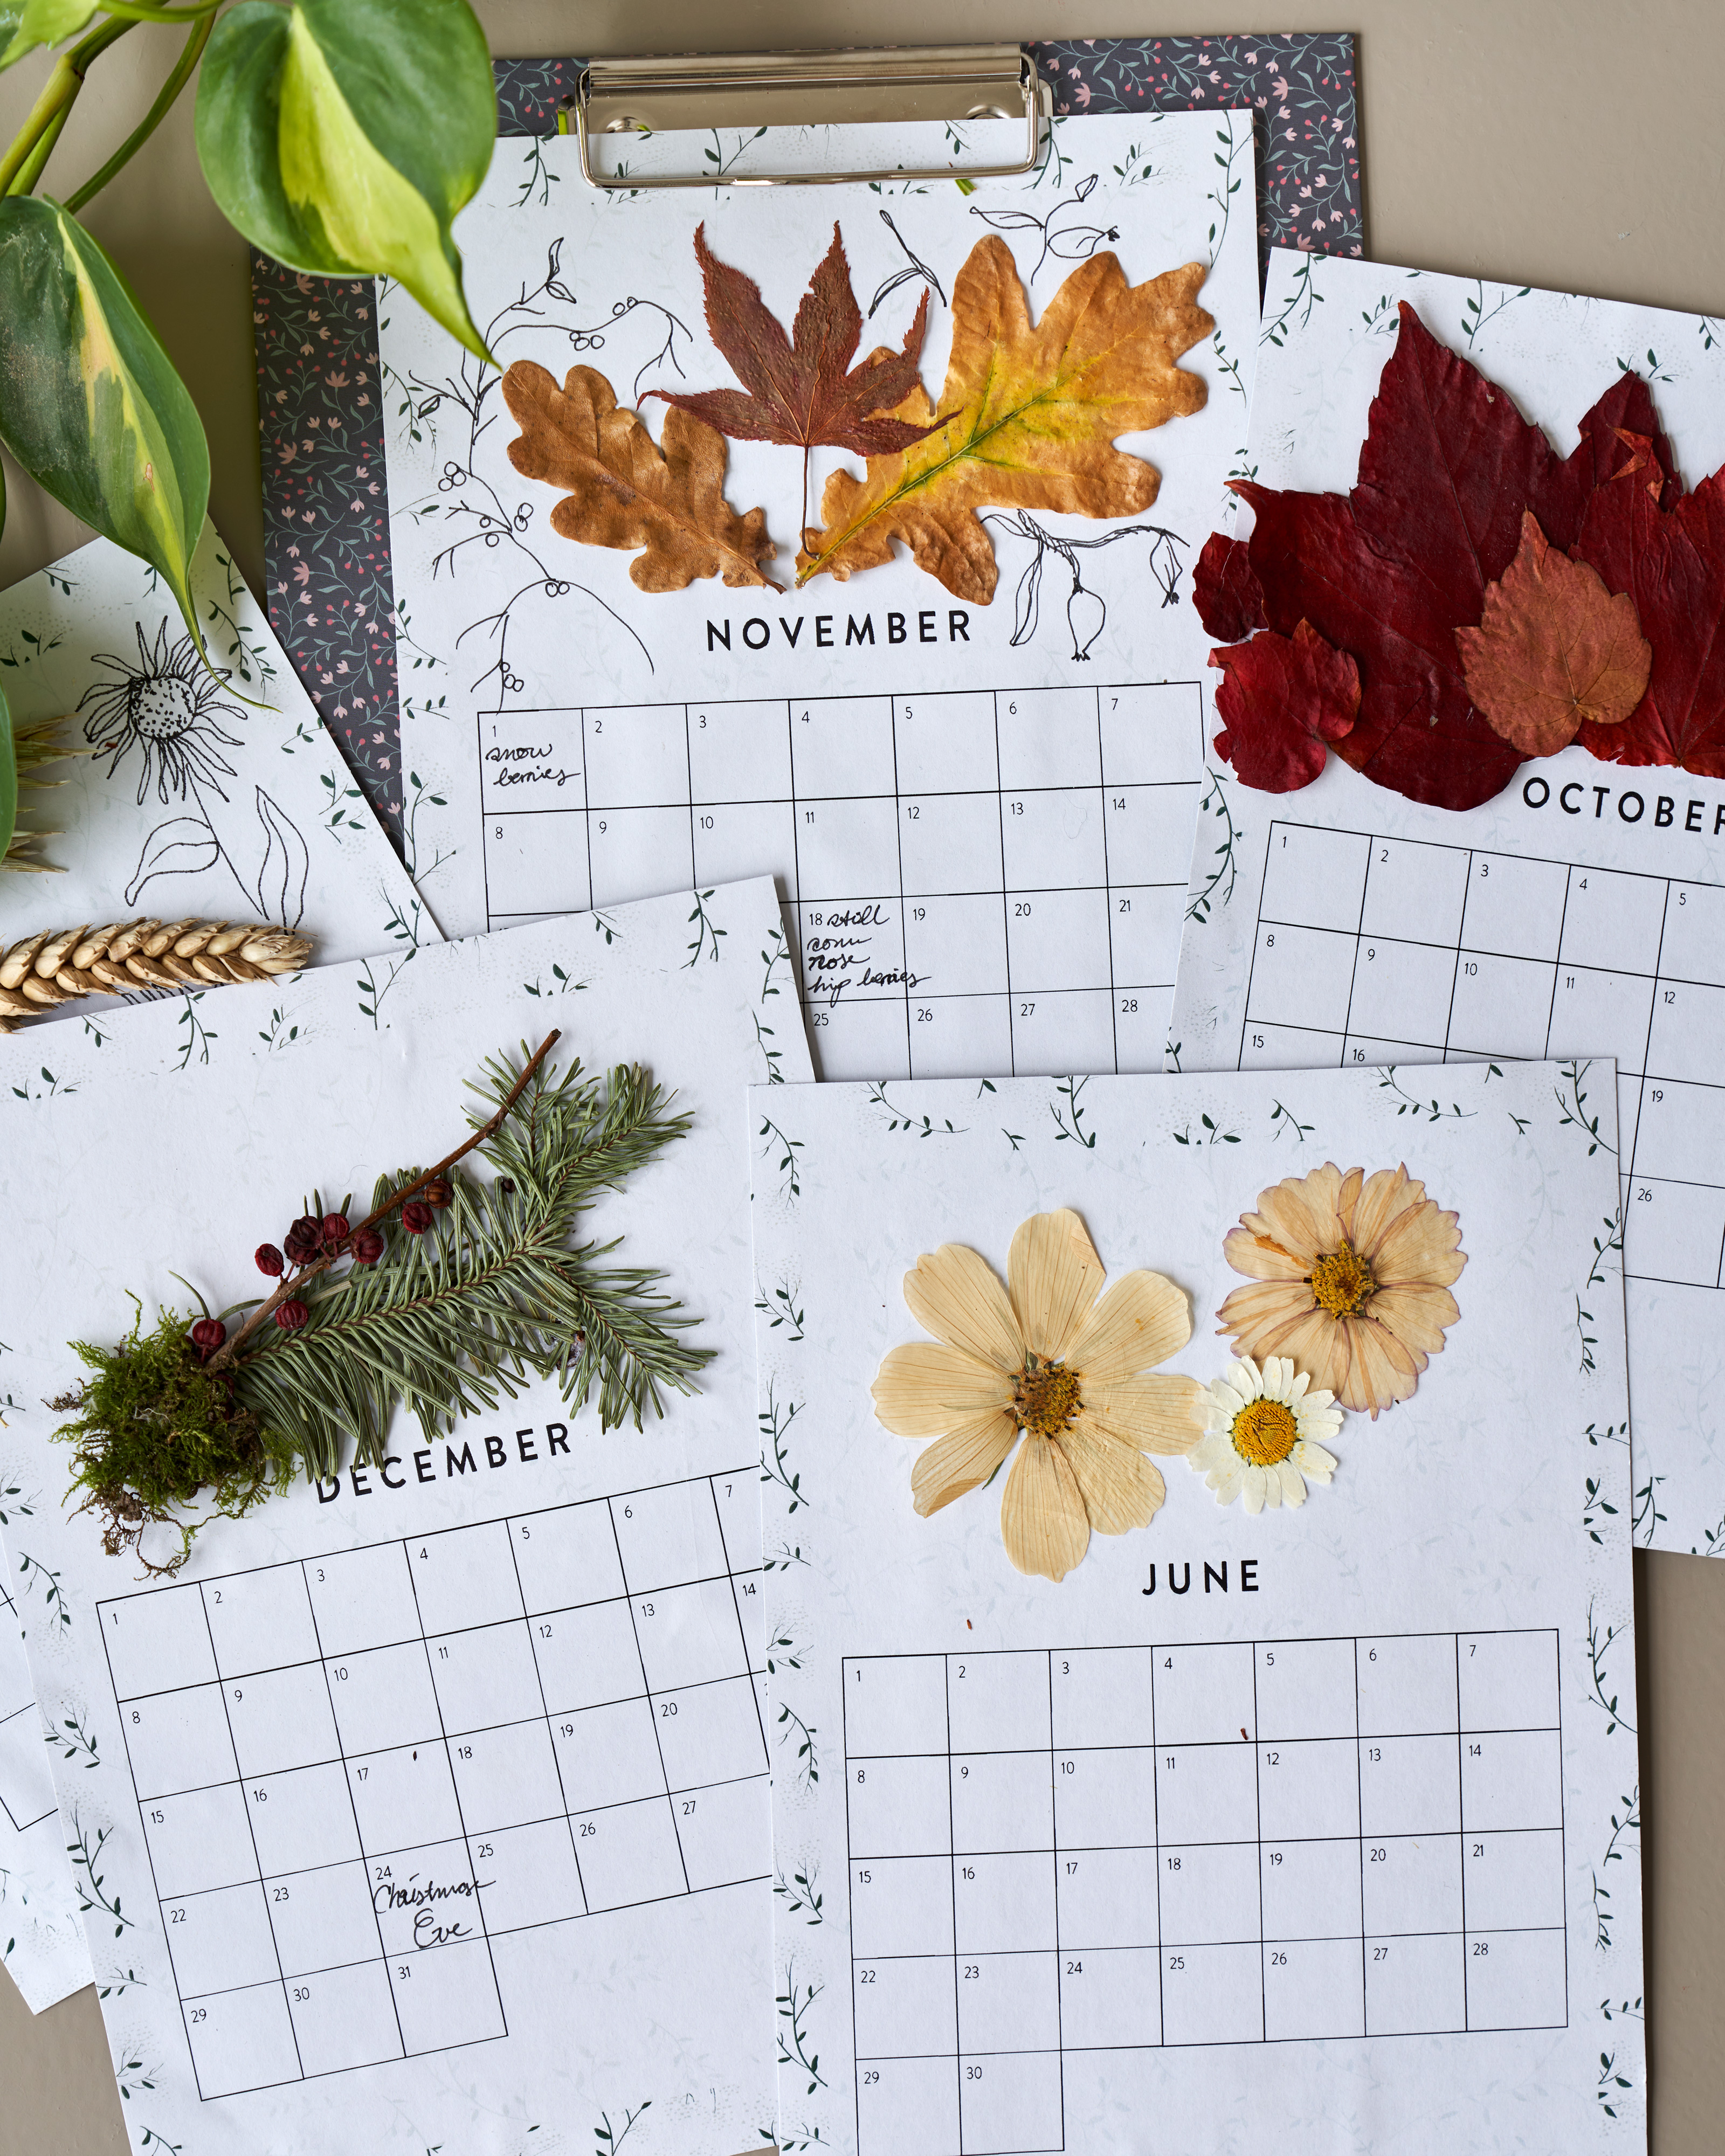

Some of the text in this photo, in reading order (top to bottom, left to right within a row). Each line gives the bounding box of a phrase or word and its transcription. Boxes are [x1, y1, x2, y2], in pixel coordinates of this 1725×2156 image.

[706, 610, 970, 652] NOVEMBER
[1009, 701, 1017, 715] 6
[1111, 698, 1119, 711] 7
[801, 710, 810, 723] 4
[905, 706, 913, 720] 5
[595, 720, 603, 734] 2
[699, 715, 707, 728] 3
[492, 725, 496, 737] 1
[485, 743, 553, 762] snow
[1011, 802, 1024, 816] 13
[1112, 798, 1126, 811] 14
[805, 811, 815, 824] 11
[907, 806, 920, 819] 12
[599, 821, 607, 834] 9
[700, 816, 714, 829] 10
[495, 826, 503, 839] 8
[1282, 835, 1287, 848] 1
[1380, 849, 1389, 862] 2
[1480, 864, 1489, 877] 3
[1579, 878, 1588, 890] 4
[1119, 899, 1130, 913] 21
[1679, 893, 1686, 906] 5
[913, 908, 926, 921] 19
[1015, 903, 1031, 916] 20
[809, 913, 823, 926] 18
[1266, 934, 1275, 948] 8
[1368, 948, 1376, 961] 9
[1465, 962, 1478, 976] 10
[1566, 976, 1575, 990] 11
[806, 975, 852, 1008] hip
[1664, 991, 1676, 1004] 12
[1020, 1003, 1036, 1017] 27
[1121, 999, 1138, 1013] 28
[813, 1013, 829, 1026] 25
[917, 1008, 933, 1022] 26
[1252, 1034, 1264, 1048] 15
[1353, 1048, 1365, 1062] 16
[1652, 1090, 1664, 1103] 19
[1637, 1188, 1652, 1202] 26
[314, 1422, 571, 1504] DECEMBER
[724, 1484, 732, 1498] 7
[624, 1504, 633, 1518] 6
[521, 1526, 530, 1540] 5
[420, 1547, 429, 1560] 4
[316, 1568, 325, 1582] 3
[1142, 1559, 1259, 1596] JUNE
[742, 1583, 757, 1597] 14
[214, 1591, 223, 1604] 2
[641, 1603, 655, 1617] 13
[112, 1613, 118, 1625] 1
[539, 1625, 553, 1639] 12
[438, 1646, 448, 1660] 11
[1369, 1648, 1377, 1661] 6
[1469, 1644, 1476, 1657] 7
[1164, 1657, 1173, 1670] 4
[1266, 1653, 1274, 1666] 5
[334, 1667, 348, 1682] 10
[958, 1665, 966, 1678] 2
[1062, 1661, 1070, 1675] 3
[856, 1670, 861, 1682] 1
[234, 1689, 243, 1703] 9
[660, 1702, 678, 1717] 20
[132, 1711, 141, 1724] 8
[560, 1724, 574, 1738] 19
[458, 1746, 473, 1760] 18
[1369, 1748, 1381, 1761] 13
[1468, 1744, 1482, 1757] 14
[1166, 1757, 1175, 1770] 11
[1266, 1752, 1280, 1765] 12
[357, 1767, 369, 1781] 17
[961, 1766, 969, 1779] 9
[1061, 1761, 1075, 1774] 10
[857, 1770, 865, 1784] 8
[253, 1788, 267, 1802] 16
[682, 1800, 696, 1815] 27
[150, 1810, 164, 1824] 15
[579, 1822, 596, 1837] 26
[478, 1843, 494, 1858] 25
[1370, 1848, 1386, 1862] 20
[1473, 1844, 1484, 1857] 21
[1168, 1857, 1181, 1870] 18
[1269, 1853, 1283, 1866] 19
[375, 1865, 392, 1881] 24
[962, 1867, 975, 1880] 16
[1066, 1862, 1078, 1875] 17
[859, 1870, 872, 1883] 15
[273, 1887, 289, 1902] 23
[170, 1909, 187, 1924] 22
[413, 1908, 473, 1949] Eve
[1374, 1947, 1389, 1960] 27
[1473, 1943, 1489, 1956] 28
[1170, 1957, 1185, 1970] 25
[1271, 1952, 1287, 1965] 26
[398, 1965, 411, 1980] 31
[964, 1965, 979, 1979] 23
[1067, 1961, 1083, 1974] 24
[860, 1970, 876, 1984] 22
[293, 1987, 310, 2002] 30
[190, 2008, 207, 2023] 29
[864, 2071, 880, 2084] 29
[966, 2066, 983, 2080] 30
